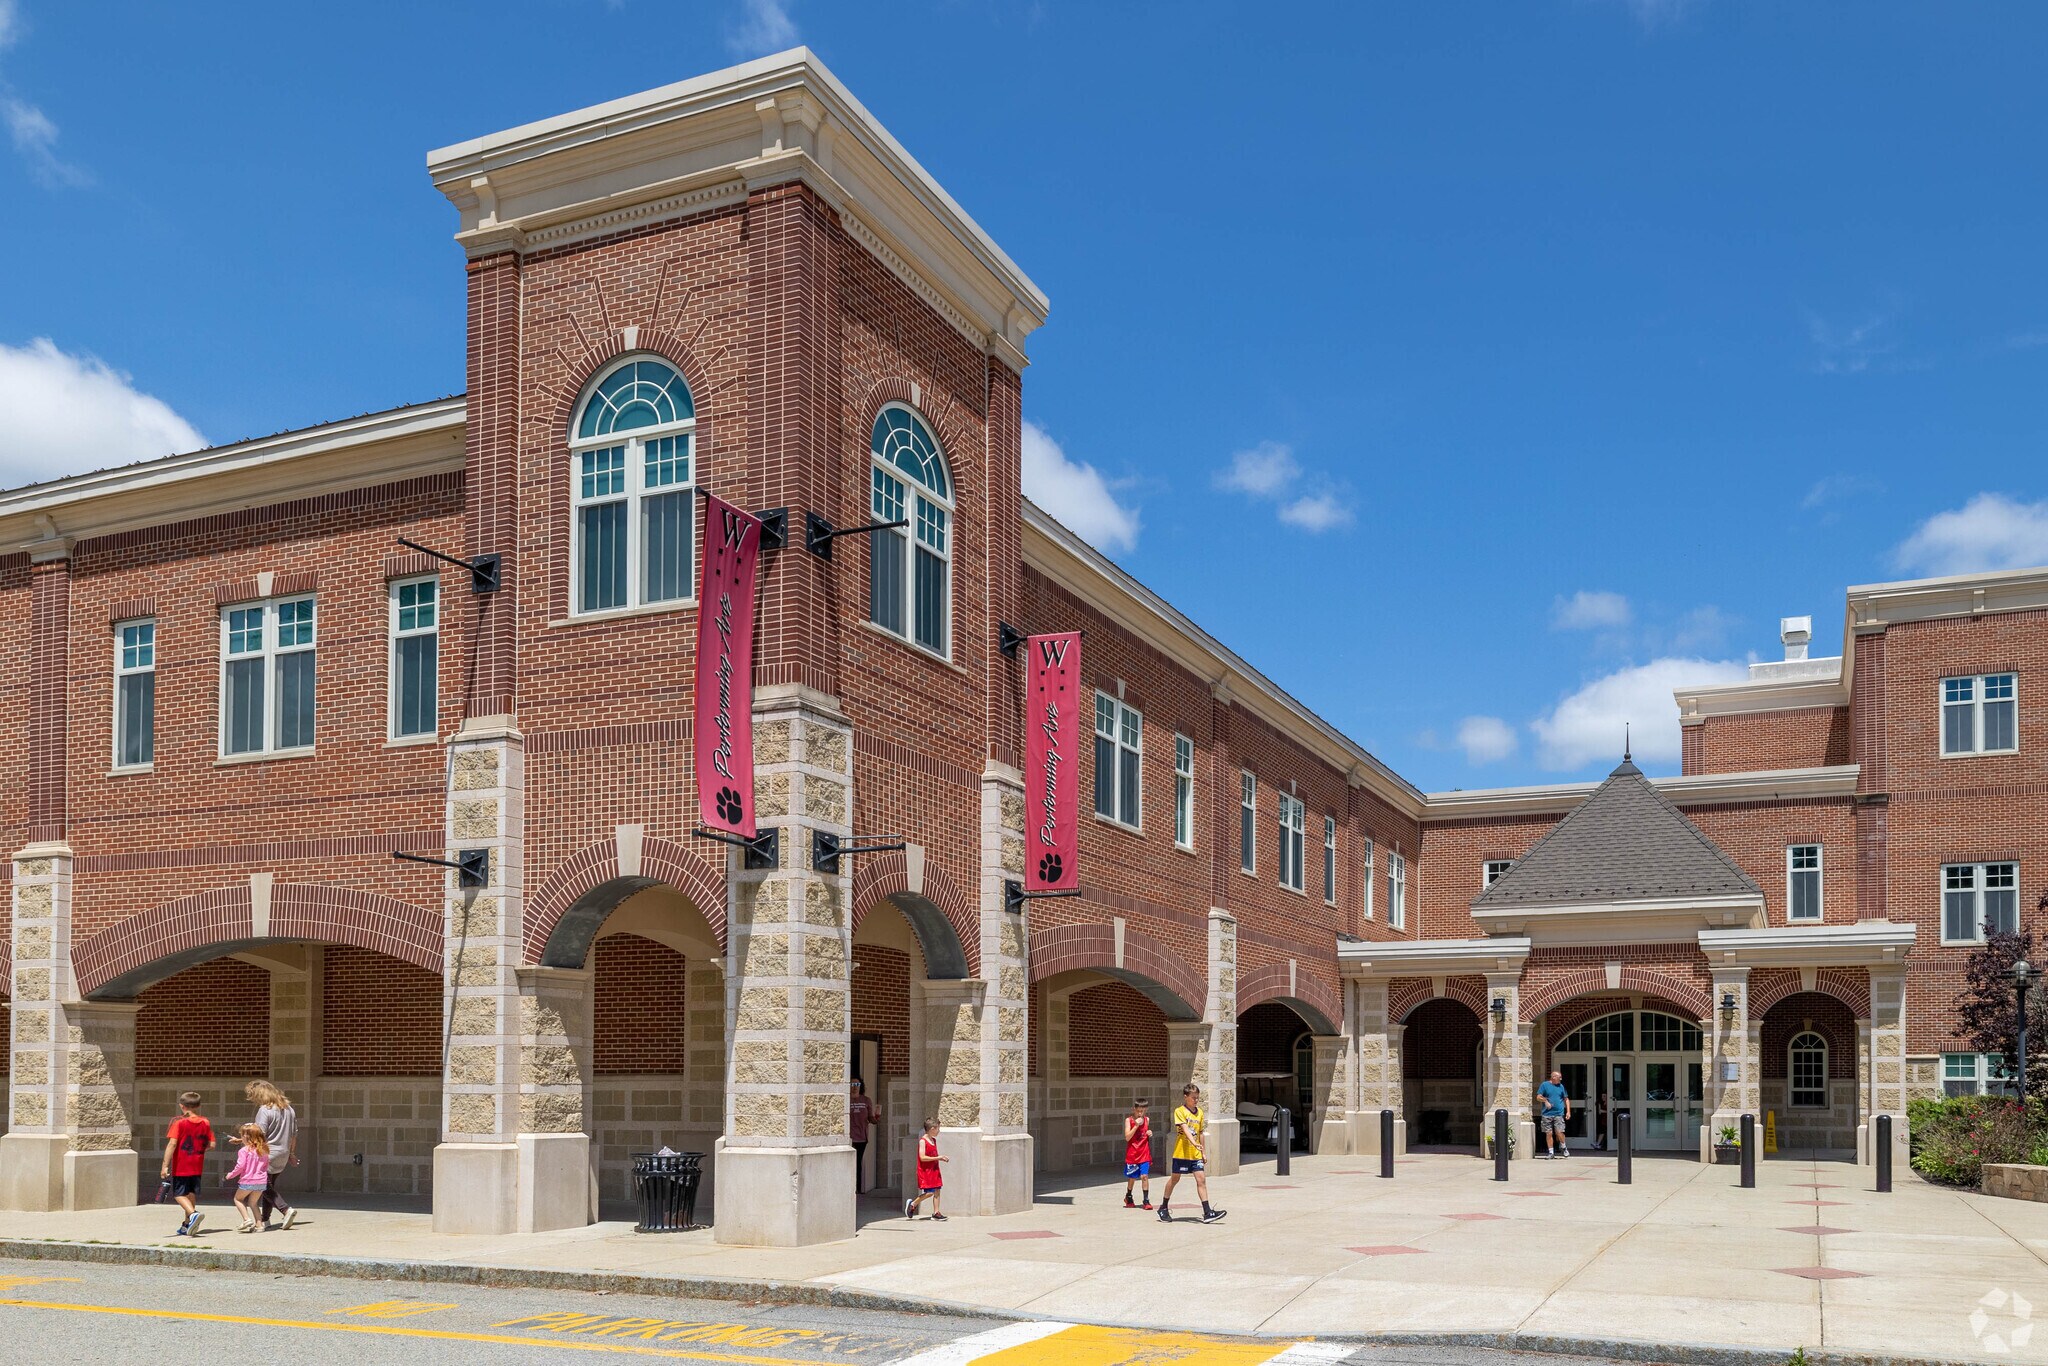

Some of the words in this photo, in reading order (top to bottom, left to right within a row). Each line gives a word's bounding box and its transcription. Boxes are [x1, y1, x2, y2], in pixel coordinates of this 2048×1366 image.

[719, 506, 753, 553] W
[714, 591, 732, 654] Arts
[1037, 639, 1071, 669] W
[713, 653, 735, 780] Performing
[1041, 701, 1059, 748] Arts
[1040, 748, 1063, 847] Performing
[490, 1311, 822, 1349] PARKING
